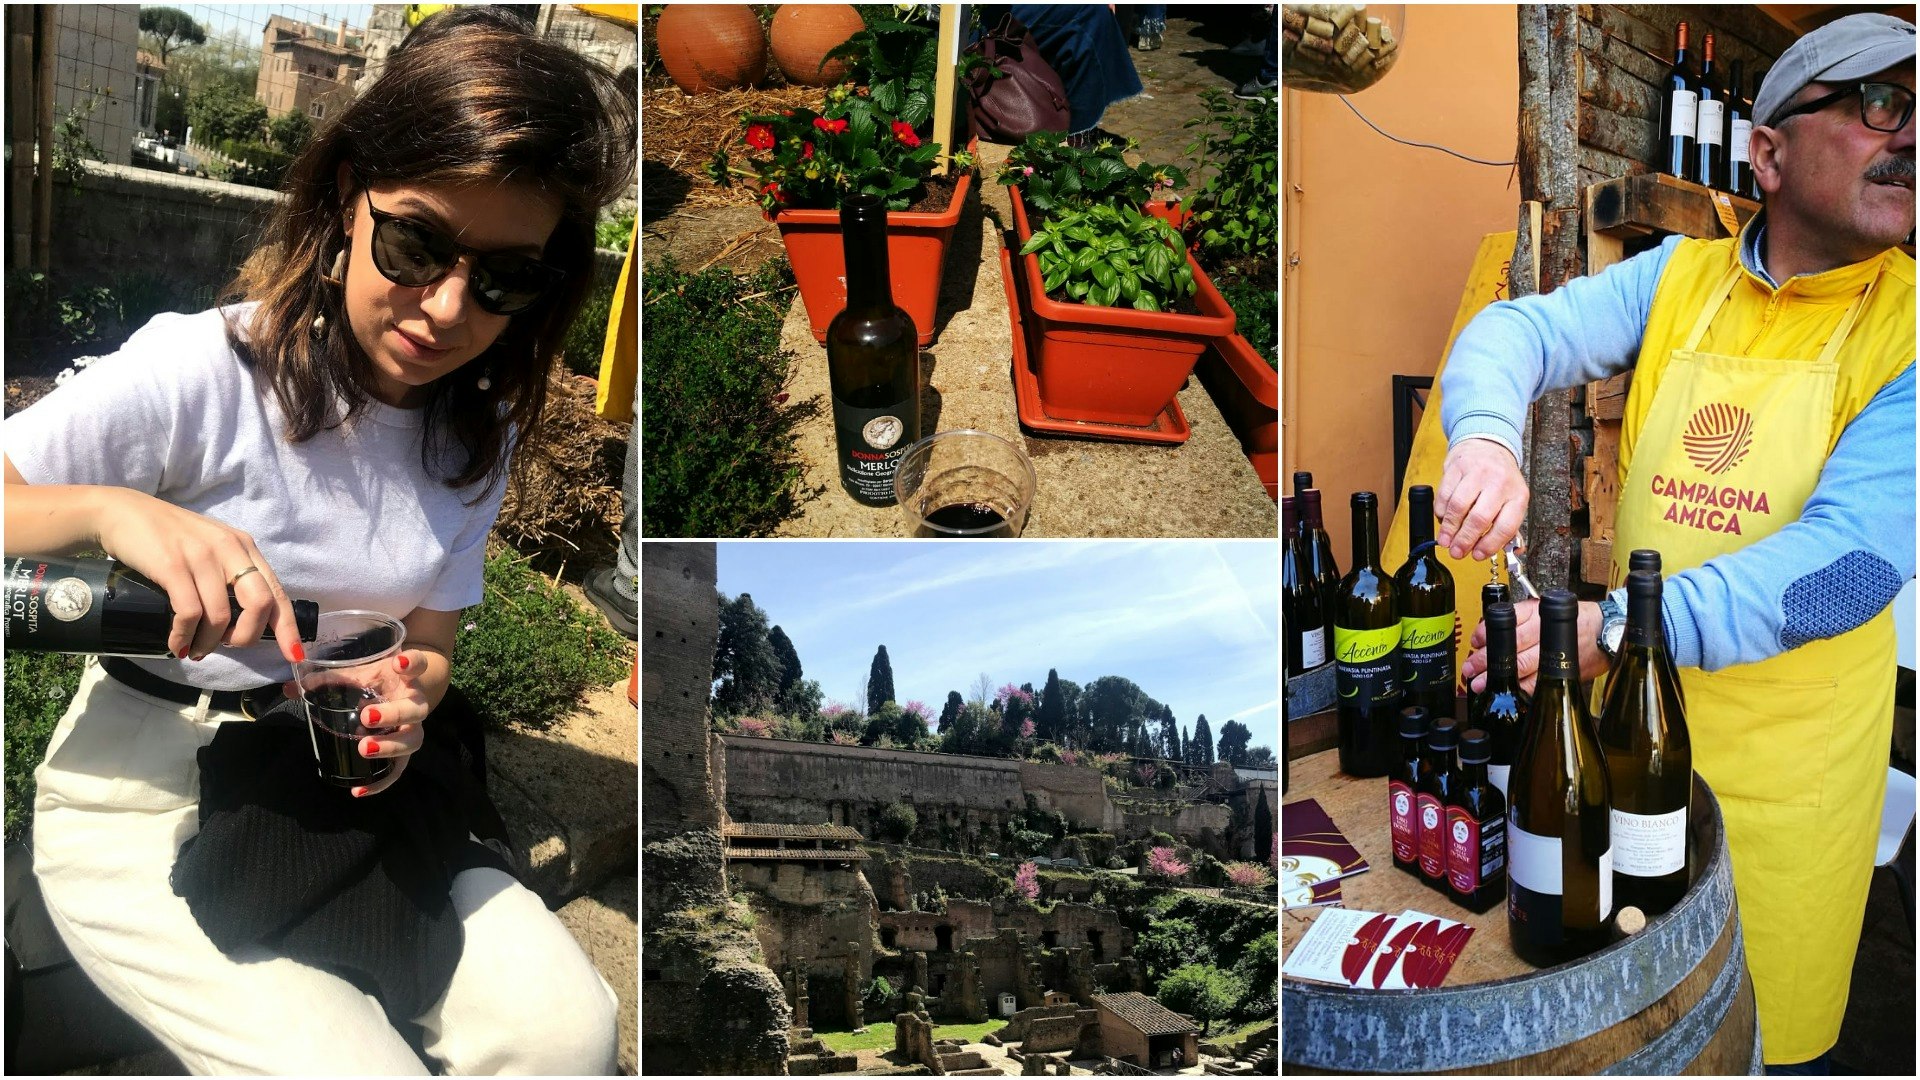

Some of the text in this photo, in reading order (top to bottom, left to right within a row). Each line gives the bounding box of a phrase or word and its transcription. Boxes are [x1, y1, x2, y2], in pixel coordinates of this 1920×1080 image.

[860, 459, 899, 471] MERLO
[1651, 475, 1770, 515] CAMPAGNA
[1663, 501, 1742, 536] AMICA
[13, 568, 33, 621] MERLOT
[1613, 815, 1680, 829] VINO BIANCO
